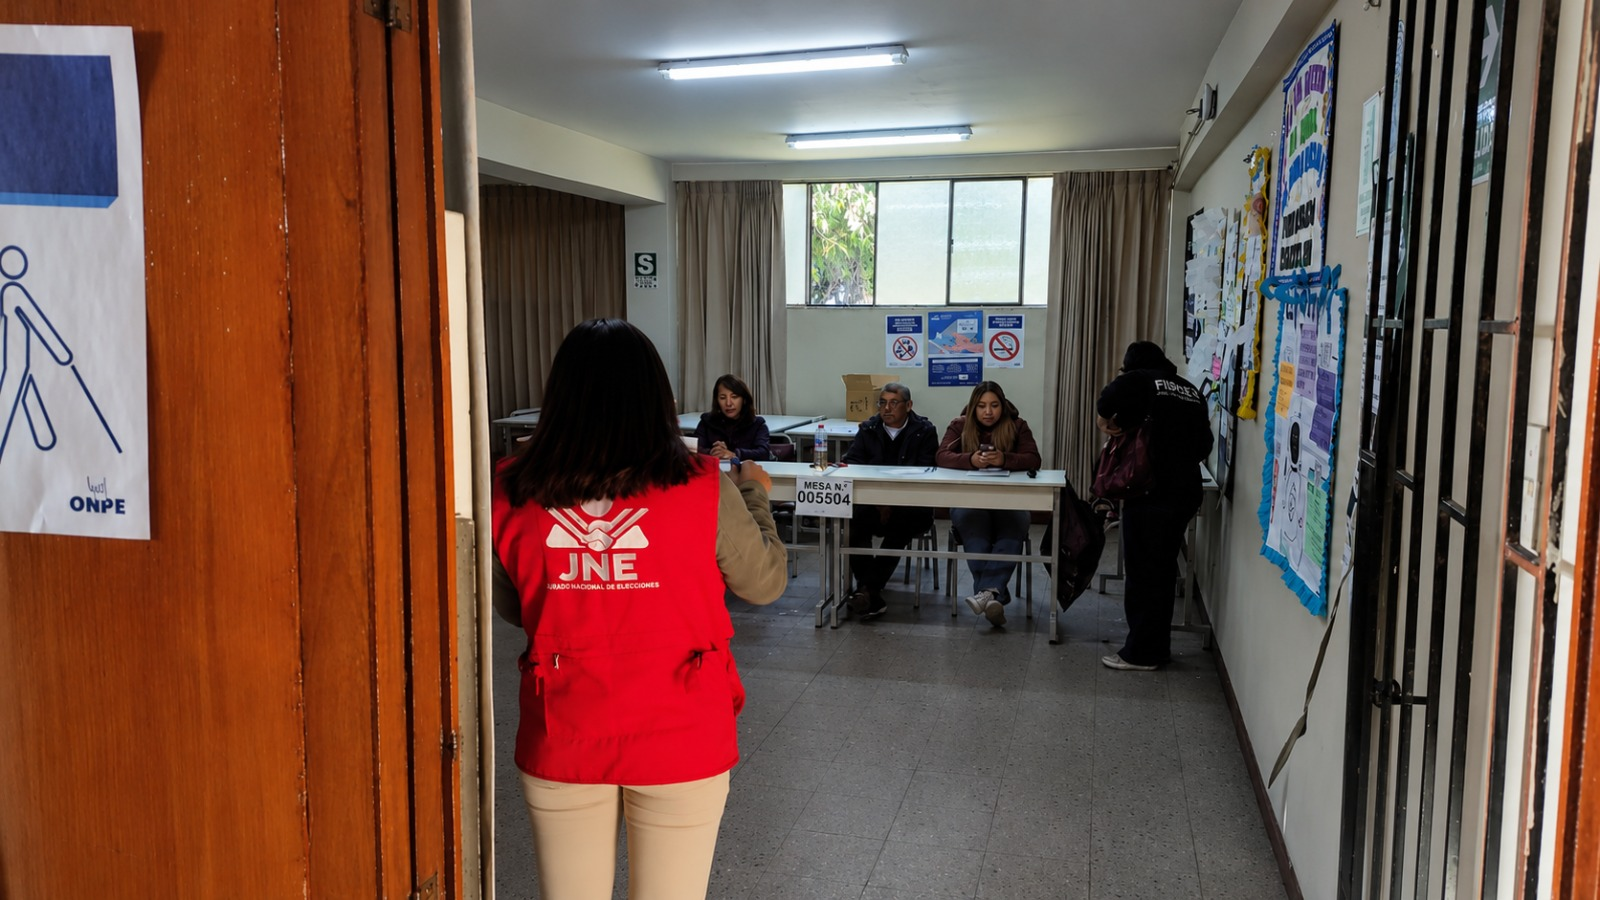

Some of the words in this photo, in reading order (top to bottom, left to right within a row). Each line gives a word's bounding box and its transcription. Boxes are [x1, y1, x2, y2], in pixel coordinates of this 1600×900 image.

[637, 254, 655, 275] S
[804, 481, 832, 491] MESA
[69, 496, 126, 514] ONPE
[797, 490, 851, 506] 005504
[559, 553, 638, 582] JNE
[571, 583, 606, 591] NACIONAL
[617, 582, 660, 590] ELECCIONES
